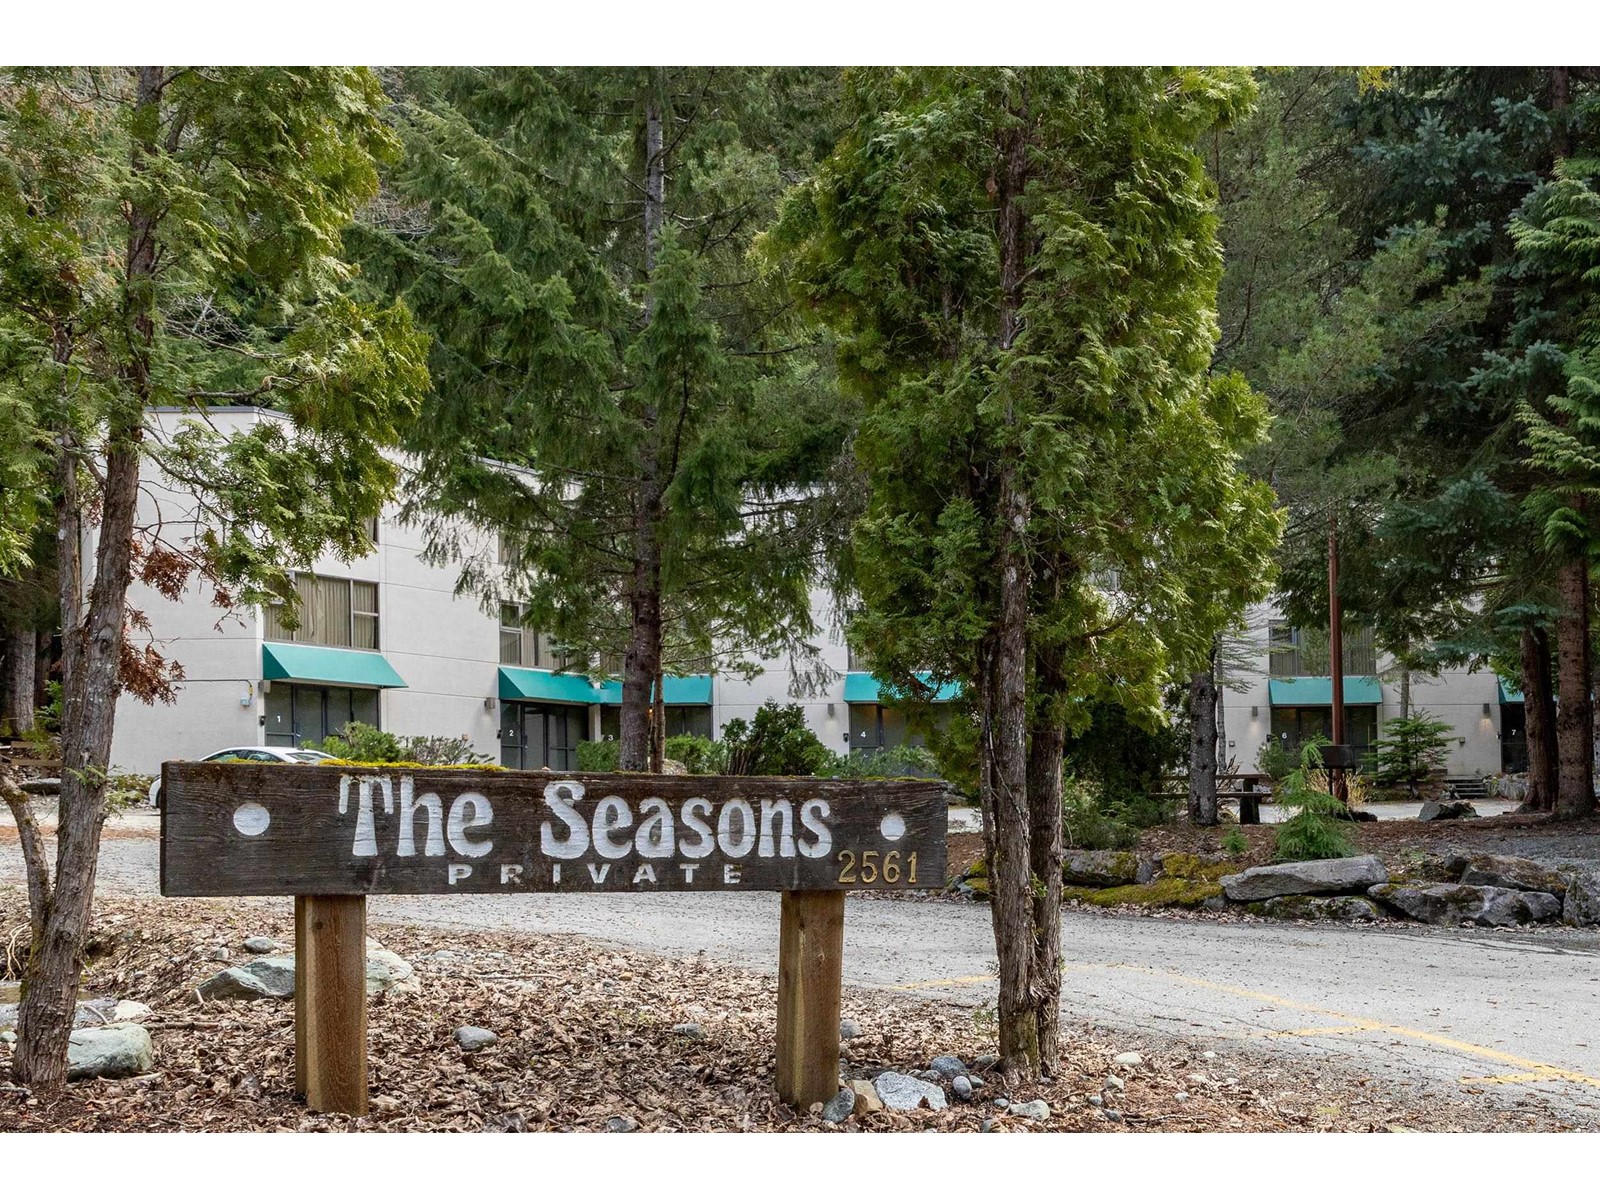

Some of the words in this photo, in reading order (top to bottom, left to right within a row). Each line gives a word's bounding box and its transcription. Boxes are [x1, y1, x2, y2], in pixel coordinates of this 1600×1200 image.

[338, 773, 494, 859] The
[540, 780, 833, 860] Seasons
[448, 863, 742, 885] PRIVATE
[838, 850, 917, 883] 2561
